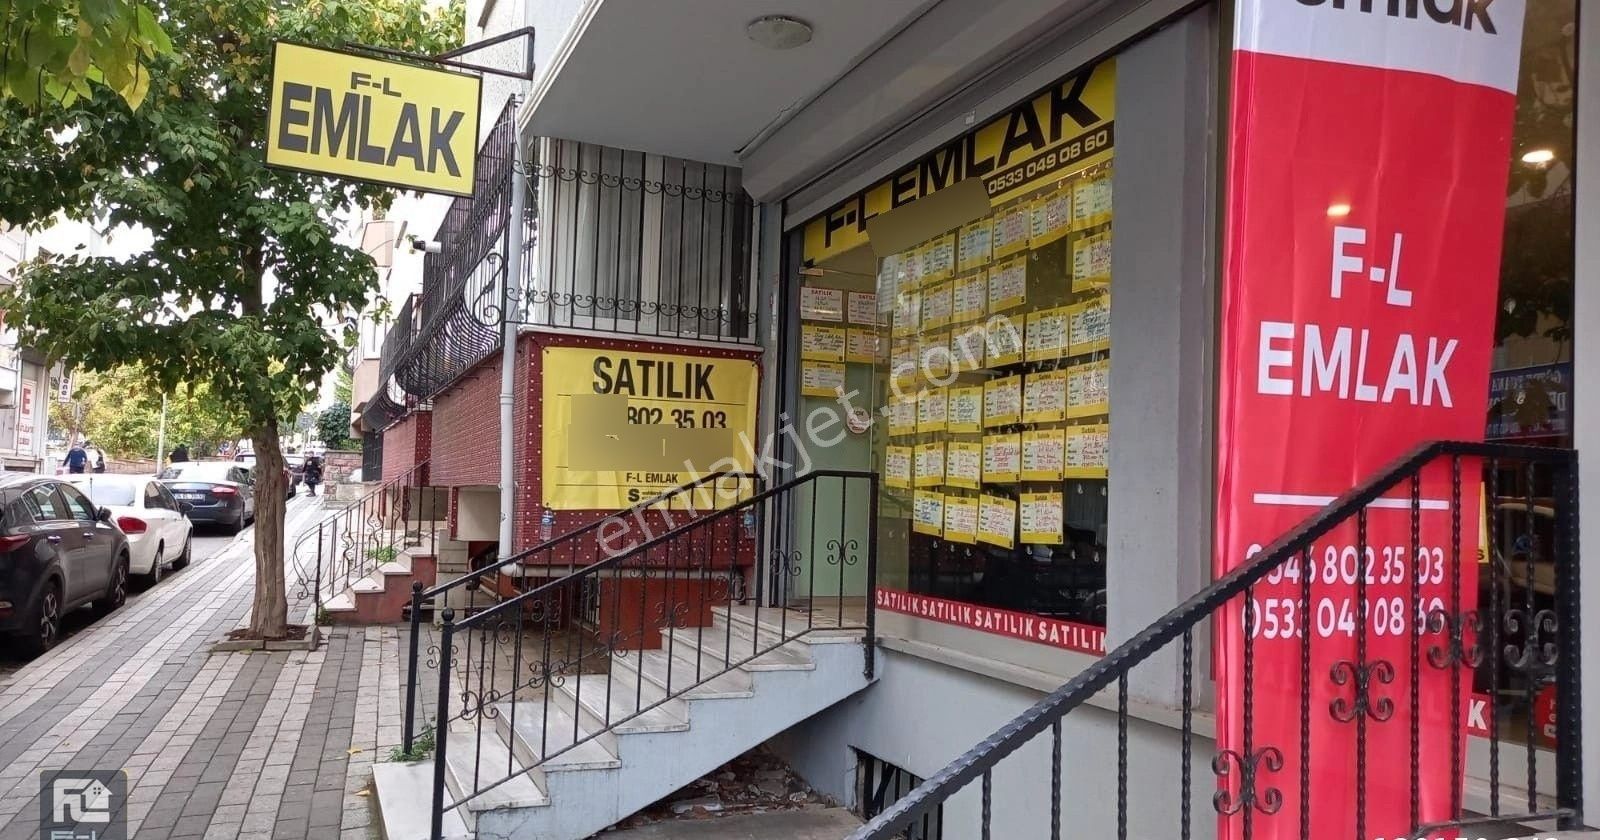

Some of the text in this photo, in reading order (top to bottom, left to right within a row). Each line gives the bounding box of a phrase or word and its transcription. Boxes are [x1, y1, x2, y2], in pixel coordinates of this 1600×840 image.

[351, 72, 402, 98] F-L
[278, 81, 466, 178] EMLAK
[891, 61, 1102, 209] EMLAK
[987, 129, 1108, 195] 0533 049 08 60
[1330, 226, 1413, 307] F-L
[592, 355, 716, 401] SATILIK
[1257, 321, 1459, 408] EMLAK
[22, 387, 32, 415] E
[670, 409, 696, 429] 35
[702, 410, 728, 429] 03
[626, 472, 679, 484] F-L EMLAK
[1322, 545, 1375, 585] 802
[1380, 546, 1406, 585] 35
[1418, 546, 1444, 585] 03
[877, 590, 919, 614] SATILIK
[921, 599, 971, 624] SATILIK
[974, 610, 1034, 637] SATILIK
[1374, 597, 1405, 637] 08
